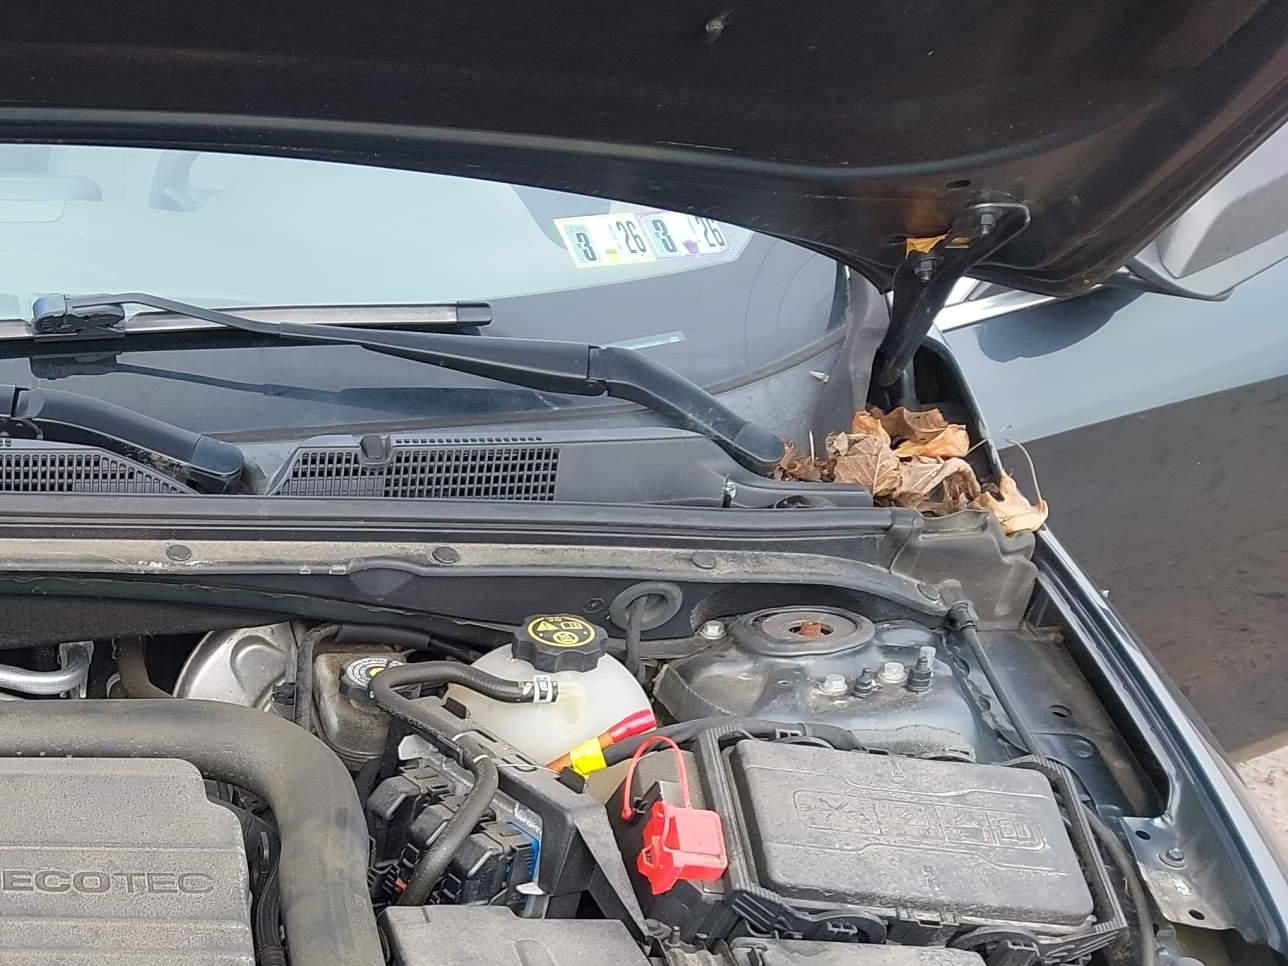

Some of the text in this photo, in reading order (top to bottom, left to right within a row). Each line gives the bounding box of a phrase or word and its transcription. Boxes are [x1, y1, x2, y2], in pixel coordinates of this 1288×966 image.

[575, 219, 647, 262] 3 26
[651, 218, 678, 253] 3
[1, 869, 215, 894] ECOTEC
